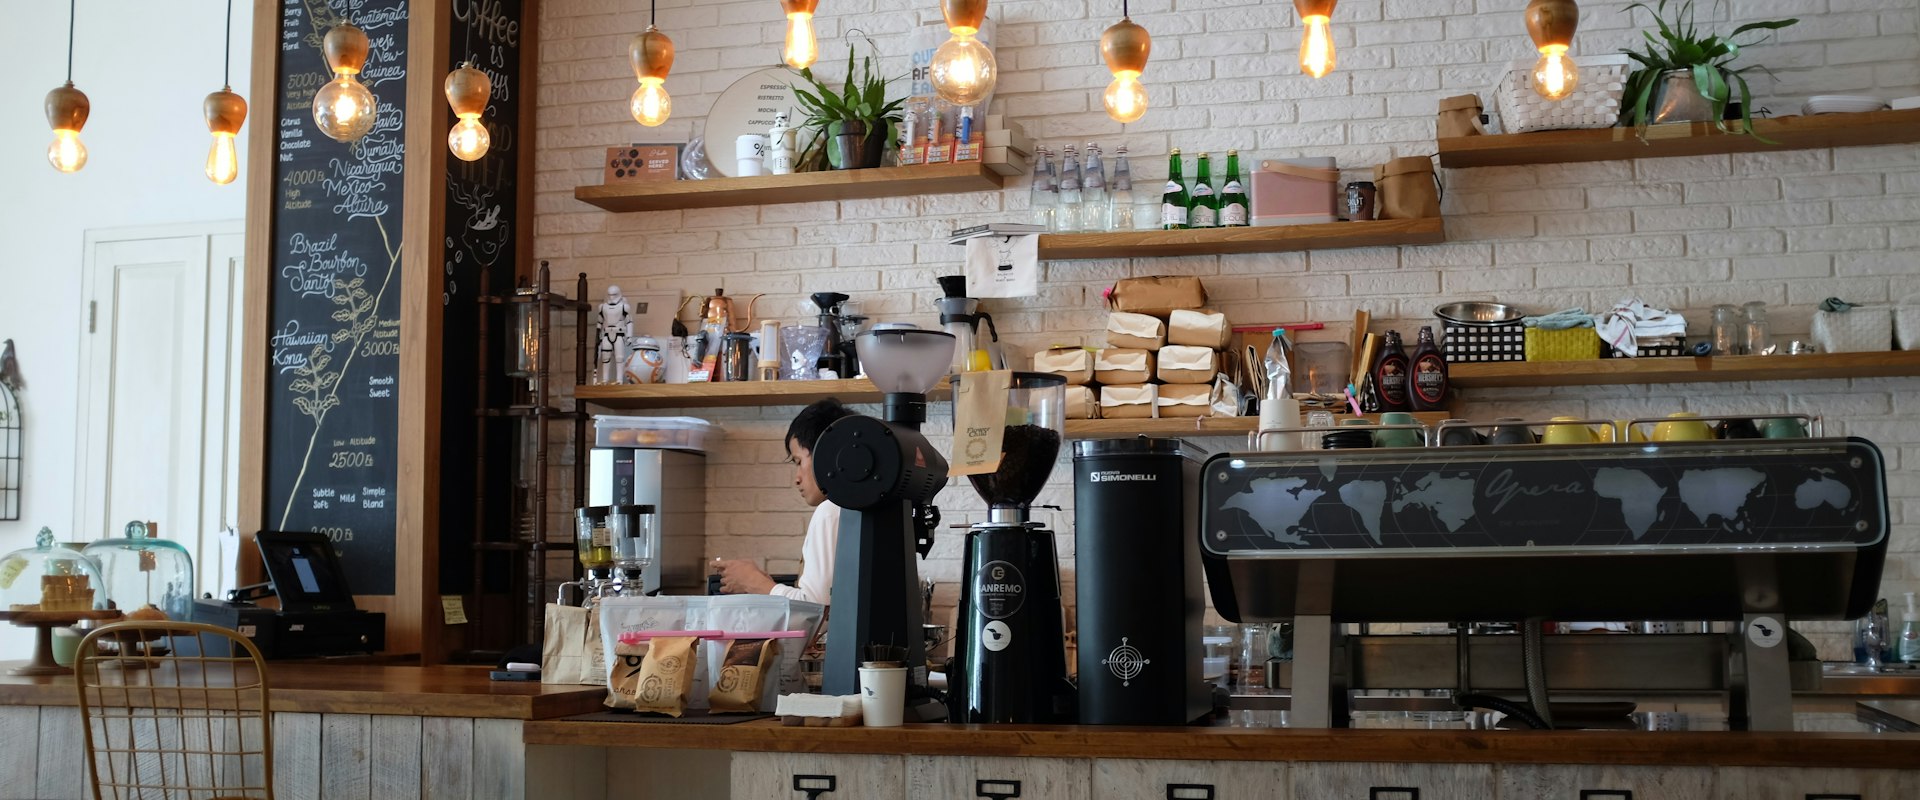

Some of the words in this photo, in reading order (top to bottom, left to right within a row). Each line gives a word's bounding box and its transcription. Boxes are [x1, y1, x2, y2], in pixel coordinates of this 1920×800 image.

[284, 8, 302, 17] Berry
[351, 1, 409, 29] Guatemala
[283, 19, 299, 28] Fruit
[283, 31, 298, 40] Spice
[283, 42, 300, 51] Floral
[371, 49, 404, 62] New
[490, 45, 504, 68] is
[361, 61, 405, 87] Guinea
[287, 72, 317, 89] 5000
[281, 118, 301, 126] Citrus
[368, 110, 403, 135] Java
[281, 129, 302, 139] Vanilla
[280, 140, 311, 150] Chocolate
[356, 134, 405, 163] Sumatra
[280, 152, 293, 162] Nut
[329, 158, 403, 181] Nicaragua
[284, 169, 316, 186] 4000
[322, 179, 386, 197] Mexico
[285, 190, 300, 199] High
[285, 200, 312, 210] Altitude
[333, 194, 388, 220] Altura
[290, 232, 338, 256] Brazil
[307, 250, 367, 277] Bourbon
[282, 261, 335, 299] Santos
[271, 320, 334, 352] Hawaiian
[373, 330, 398, 338] Altitude
[361, 341, 391, 357] 3000
[273, 347, 307, 374] Kona
[368, 376, 394, 386] Smooth
[368, 388, 390, 398] Sweet
[333, 439, 345, 447] Low
[350, 435, 376, 446] Altitude
[329, 452, 365, 469] 2500
[1101, 474, 1156, 482] SIMONELLI
[313, 488, 335, 498] Subtle
[362, 486, 386, 497] Simple
[1485, 468, 1585, 515] Opera
[339, 493, 356, 503] Mild
[313, 500, 329, 509] Soft
[362, 500, 384, 509] Bland
[980, 583, 1022, 593] ANREMO
